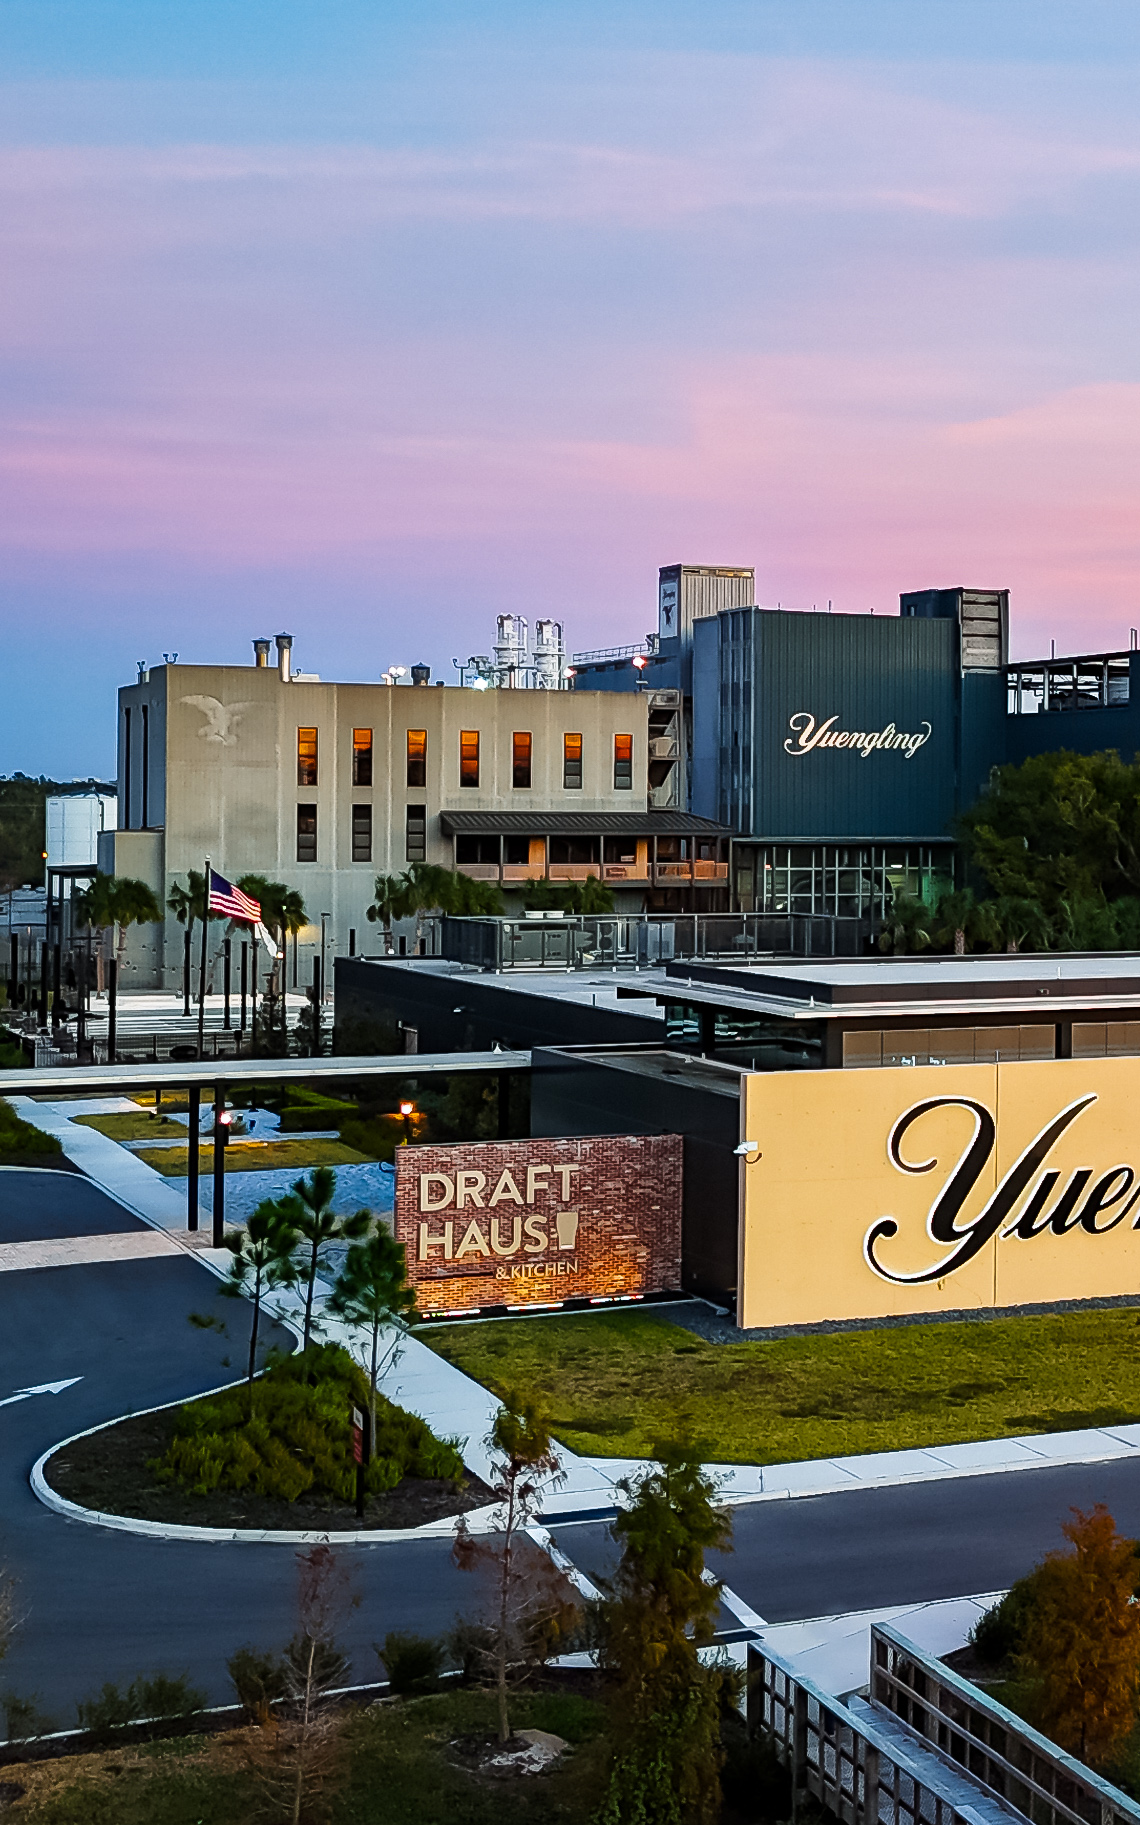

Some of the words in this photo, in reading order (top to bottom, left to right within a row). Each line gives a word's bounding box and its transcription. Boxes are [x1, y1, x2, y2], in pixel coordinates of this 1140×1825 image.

[784, 712, 932, 759] Yuengling
[419, 1163, 580, 1212] DRAFT
[418, 1214, 549, 1261] HAUS
[495, 1266, 511, 1280] &
[511, 1260, 579, 1279] KITCHEN
